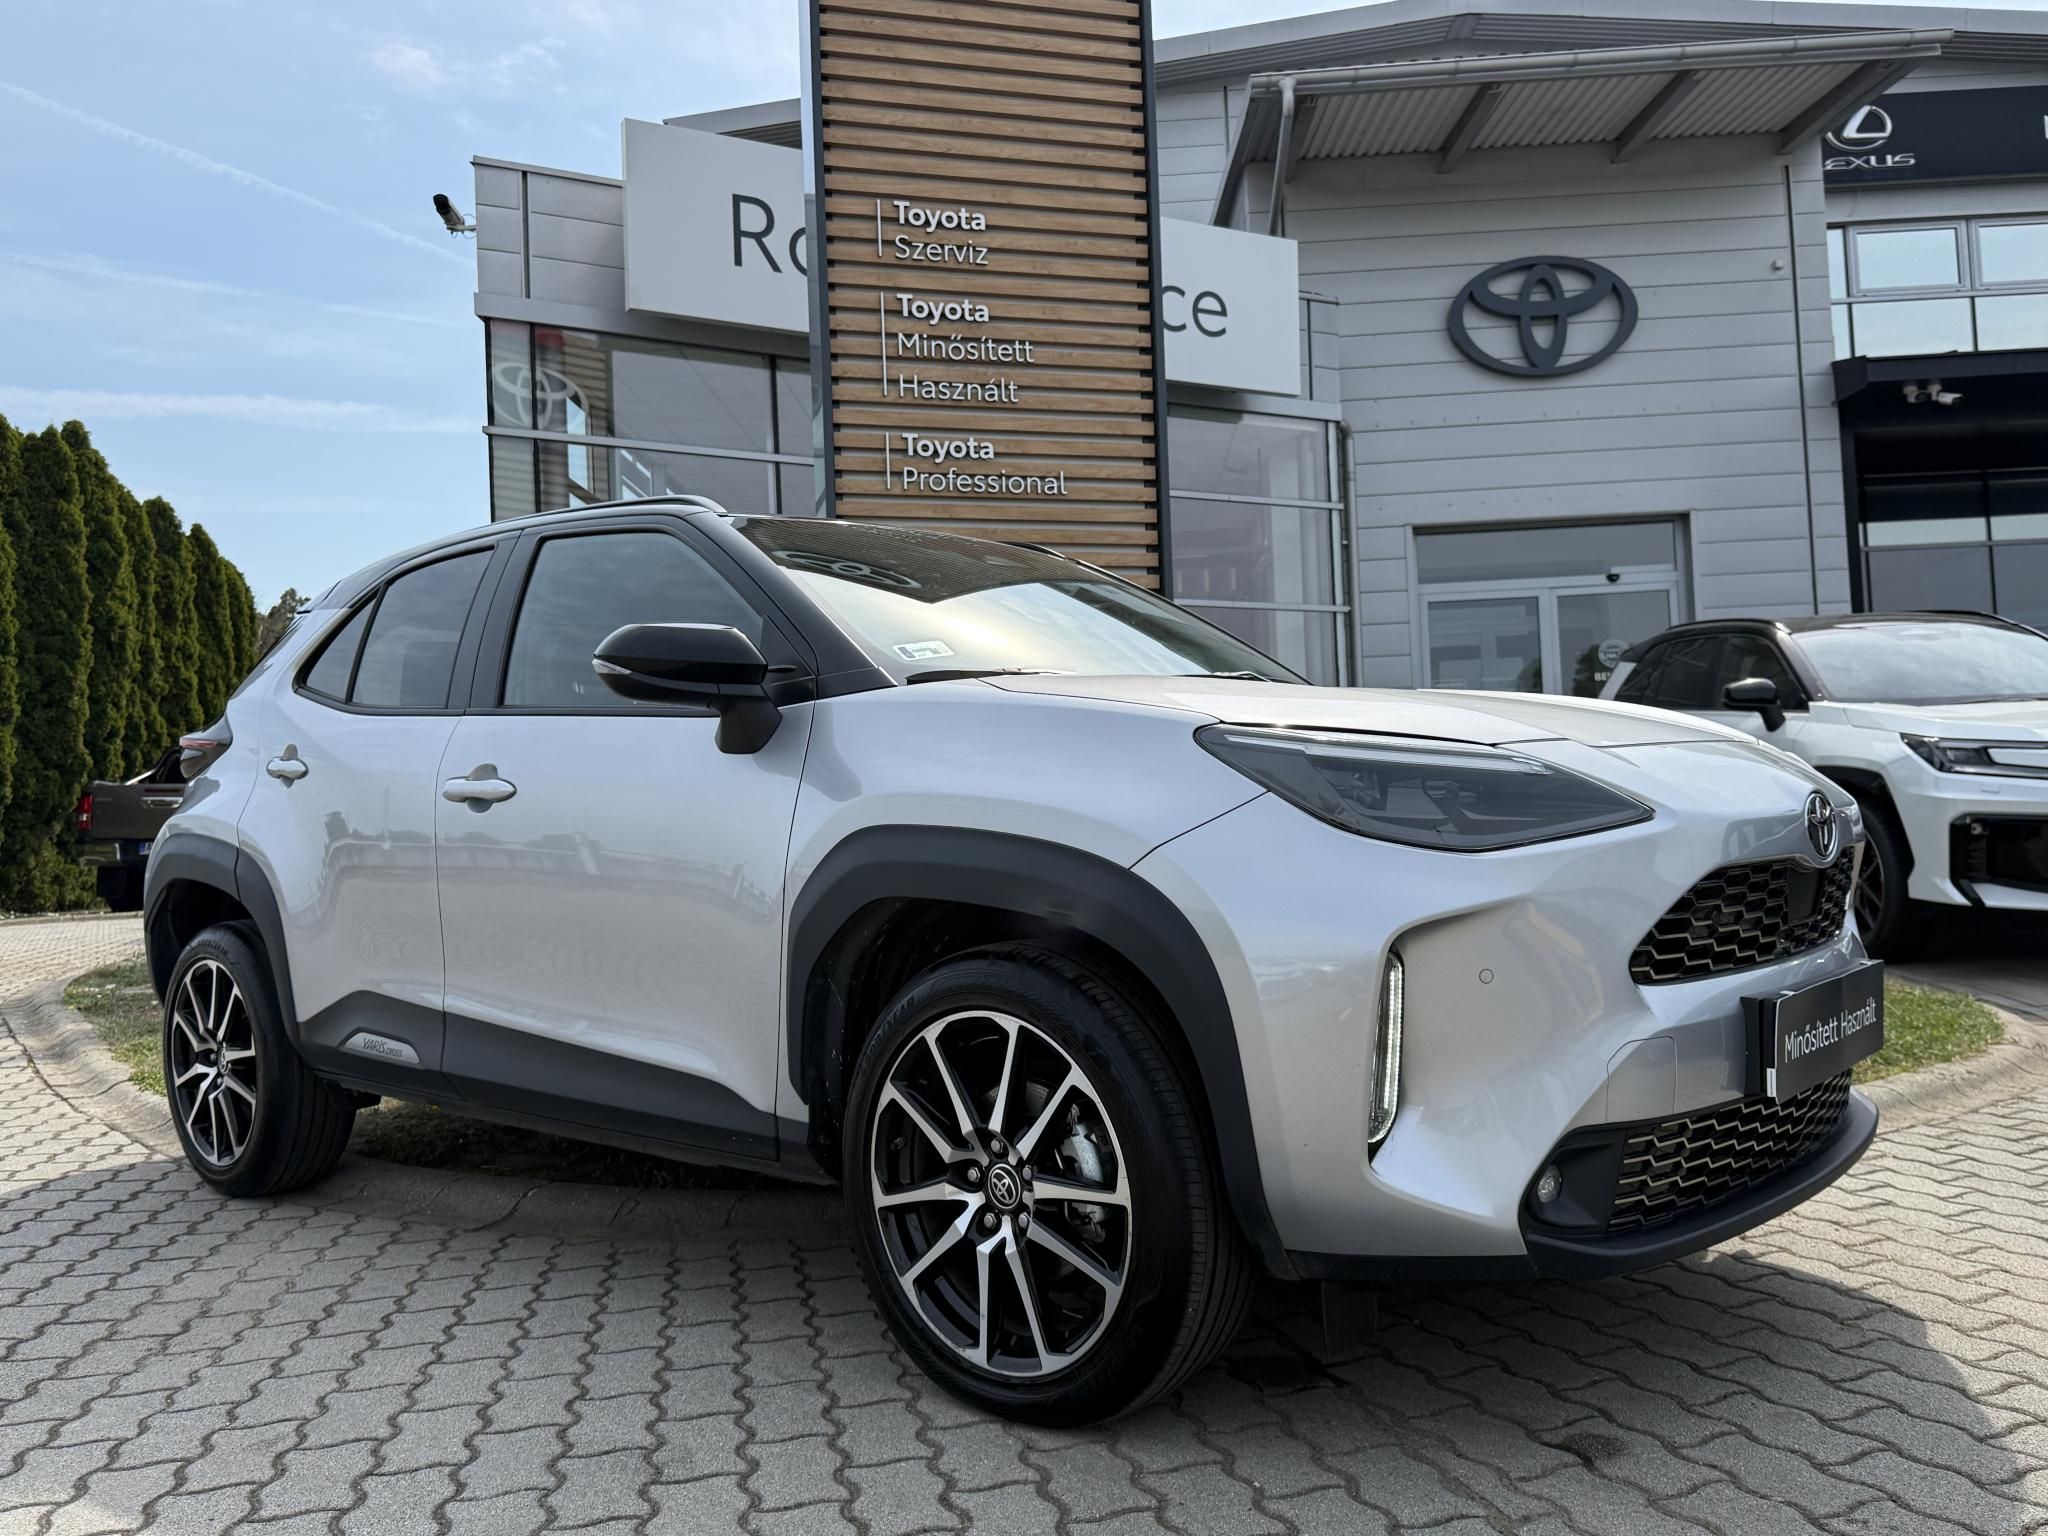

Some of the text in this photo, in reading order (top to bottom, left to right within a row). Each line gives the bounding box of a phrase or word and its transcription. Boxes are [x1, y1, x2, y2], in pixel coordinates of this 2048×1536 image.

[1823, 153, 1916, 170] EXUS
[893, 200, 987, 233] Toyota
[894, 234, 989, 266] Szerviz
[896, 293, 990, 325] Toyota
[897, 331, 1035, 363] Minősített
[899, 373, 1020, 403] Használt
[902, 432, 995, 464] Toyota
[903, 466, 1068, 495] Professional
[361, 1037, 386, 1054] YARIS
[1784, 995, 1877, 1064] Minősített Használt
